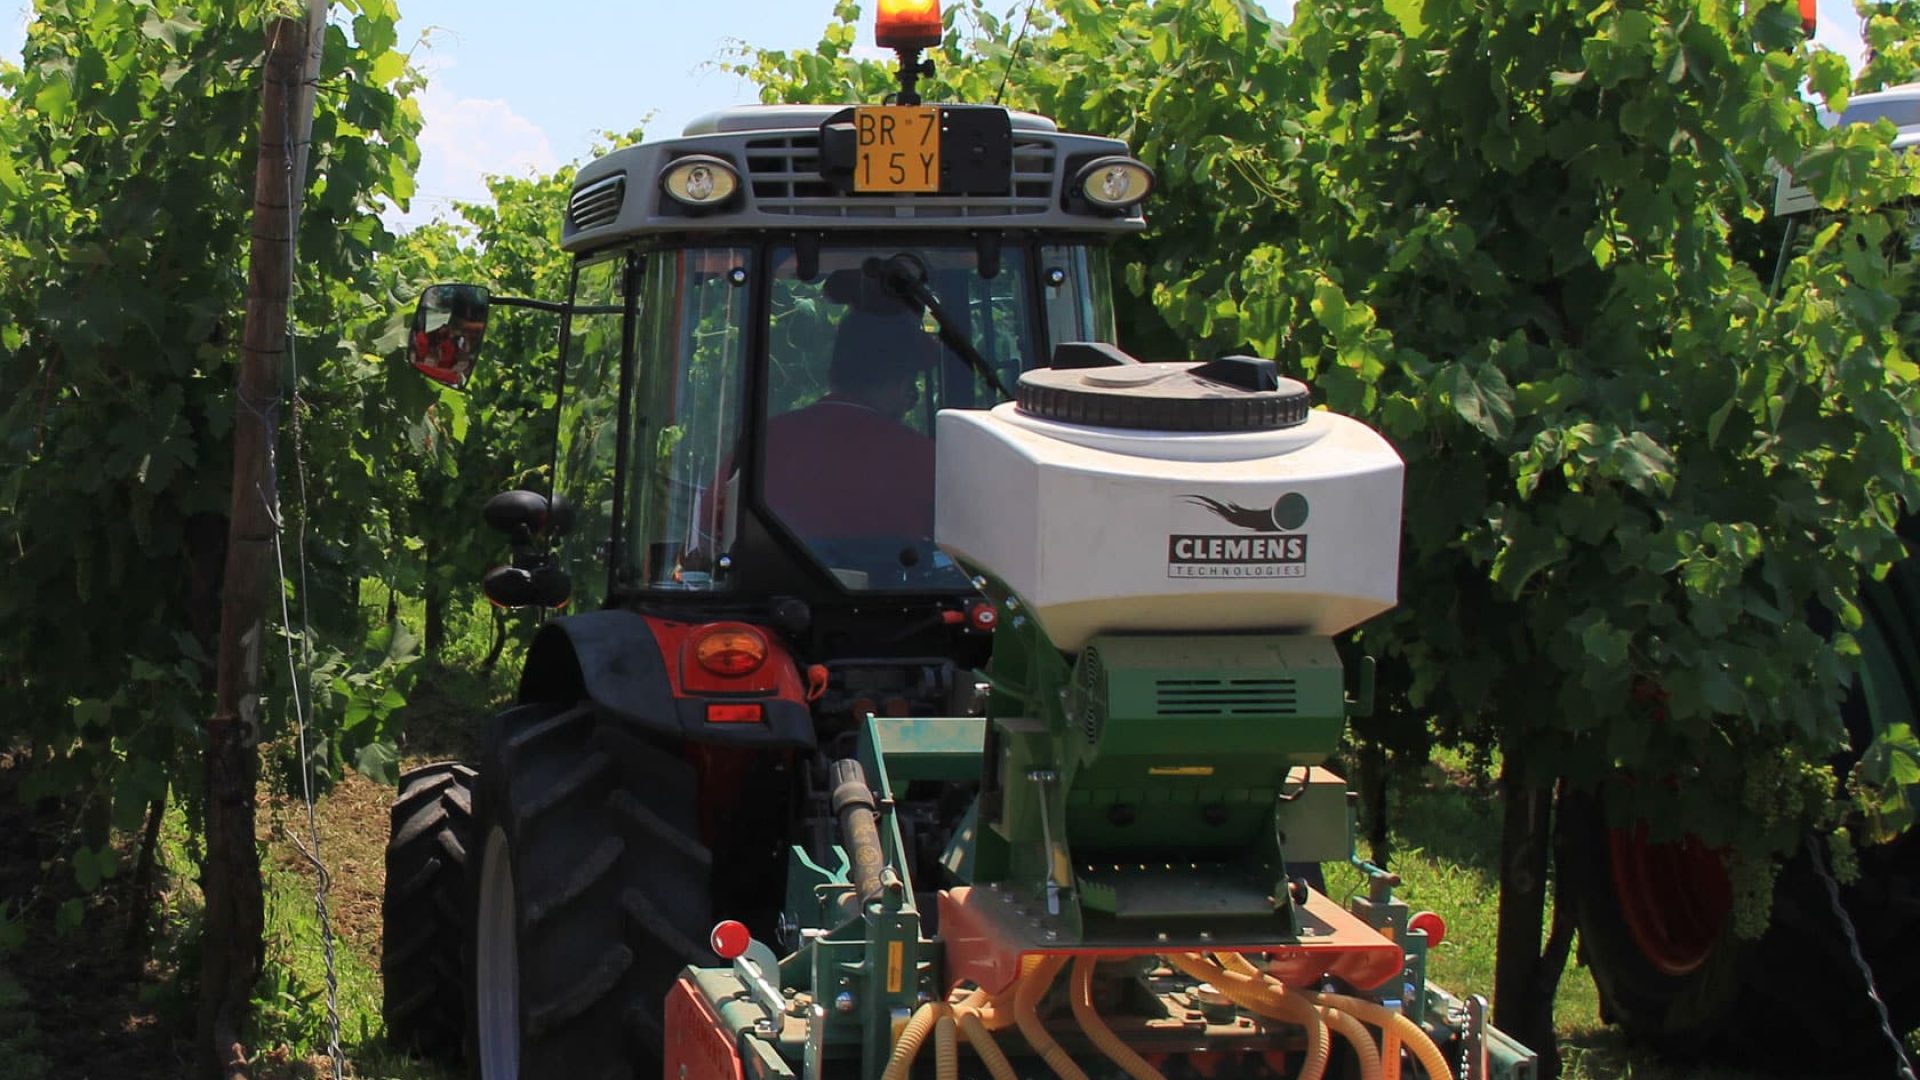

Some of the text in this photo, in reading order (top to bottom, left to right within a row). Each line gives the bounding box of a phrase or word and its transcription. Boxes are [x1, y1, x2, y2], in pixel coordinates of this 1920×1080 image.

[859, 113, 936, 147] BR 7
[1175, 538, 1302, 560] CLEMENS
[1177, 565, 1301, 577] TECHNOLOGIES
